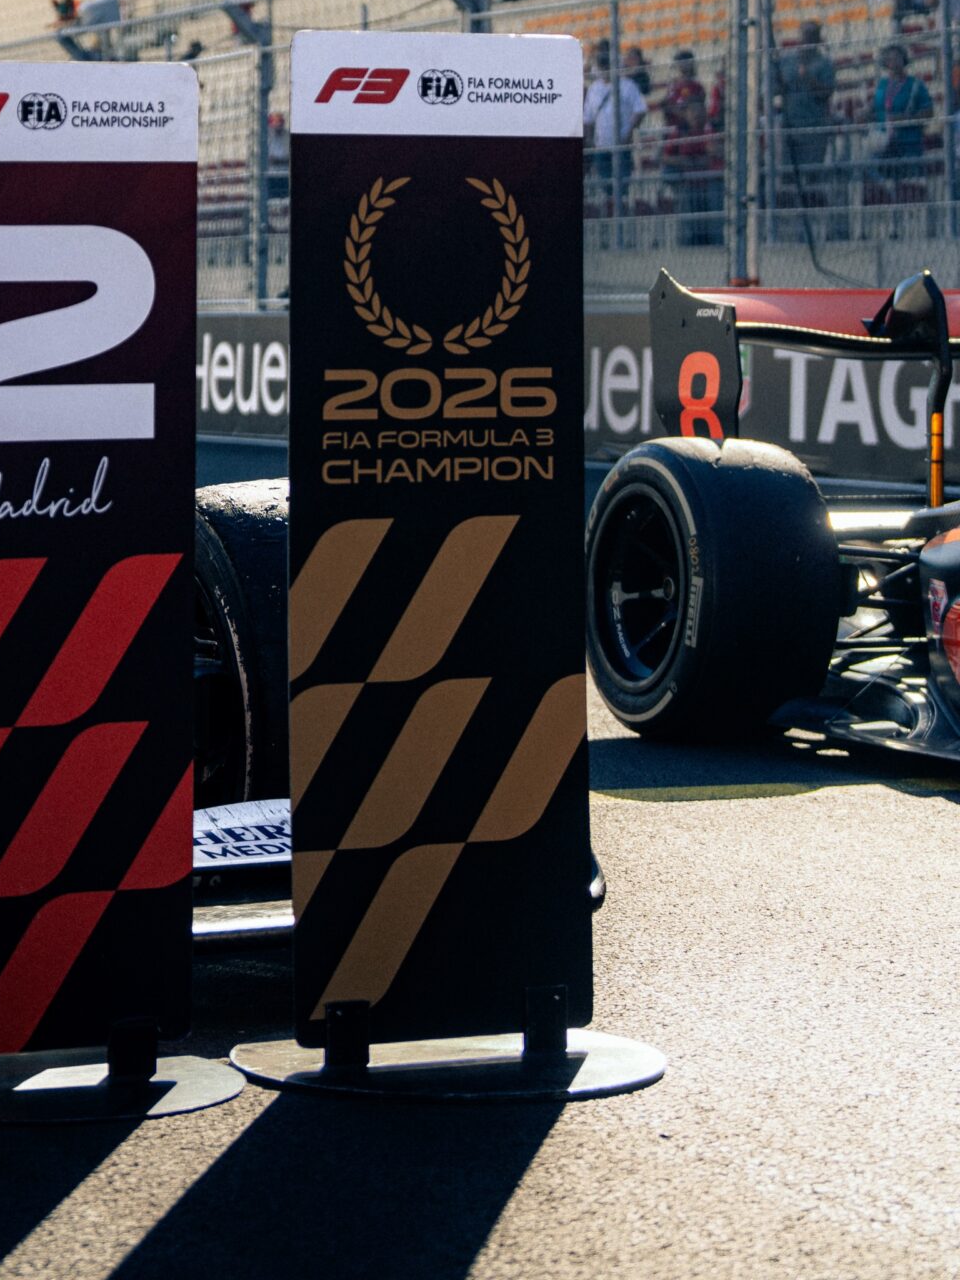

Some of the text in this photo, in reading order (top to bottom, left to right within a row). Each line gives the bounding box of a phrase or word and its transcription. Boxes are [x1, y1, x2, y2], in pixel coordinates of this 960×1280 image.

[314, 67, 410, 104] F3
[468, 77, 554, 90] FIA FORMULA 3
[71, 101, 165, 113] FIA FORMULA 3
[322, 367, 557, 420] 2026
[678, 351, 724, 442] 8
[773, 349, 929, 450] TAG
[323, 428, 554, 449] FIA FORMULA 3
[322, 456, 554, 484] CHAMPION
